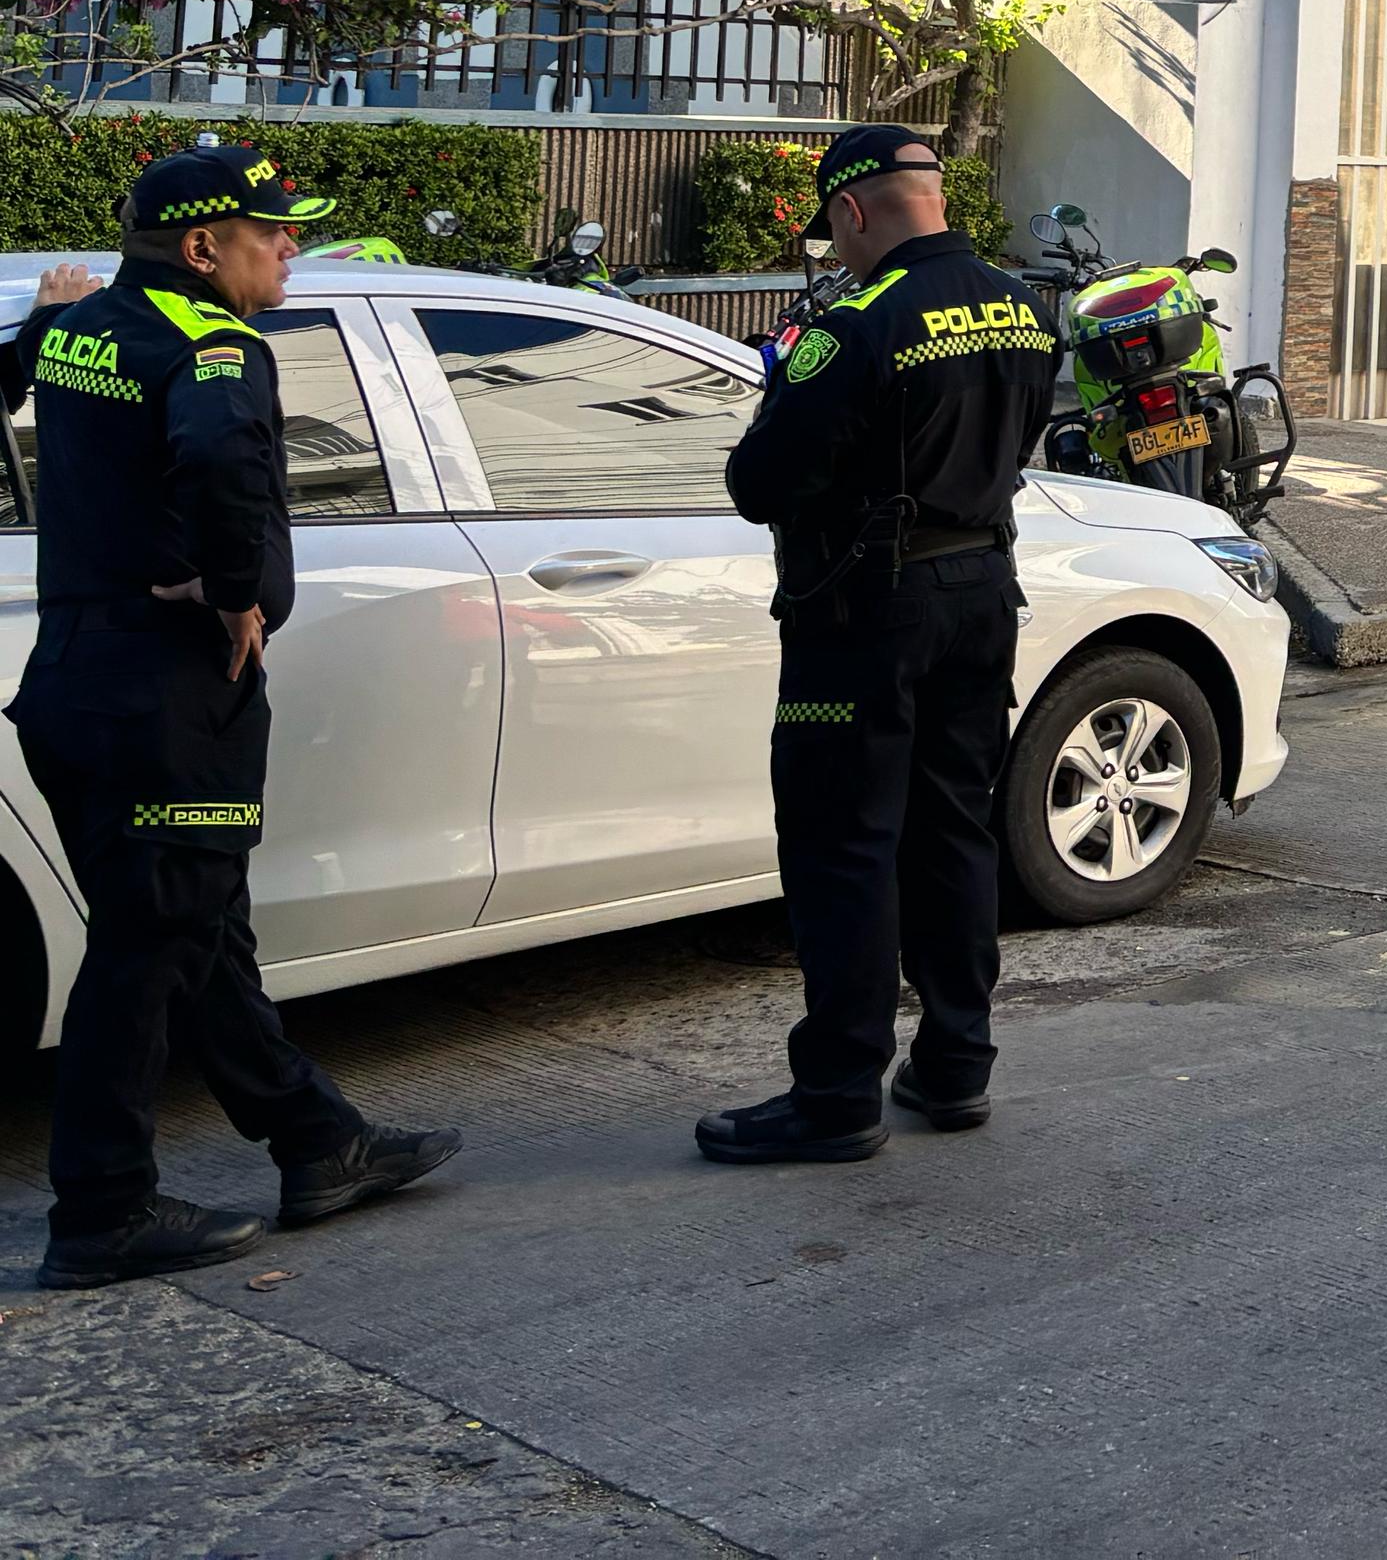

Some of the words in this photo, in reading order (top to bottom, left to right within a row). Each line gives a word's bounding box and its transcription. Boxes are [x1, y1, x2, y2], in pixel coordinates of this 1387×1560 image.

[922, 294, 1040, 338] POLICÍA
[1131, 432, 1167, 455] BGL
[1169, 420, 1202, 443] 74F
[174, 807, 243, 822] POLICÍA
